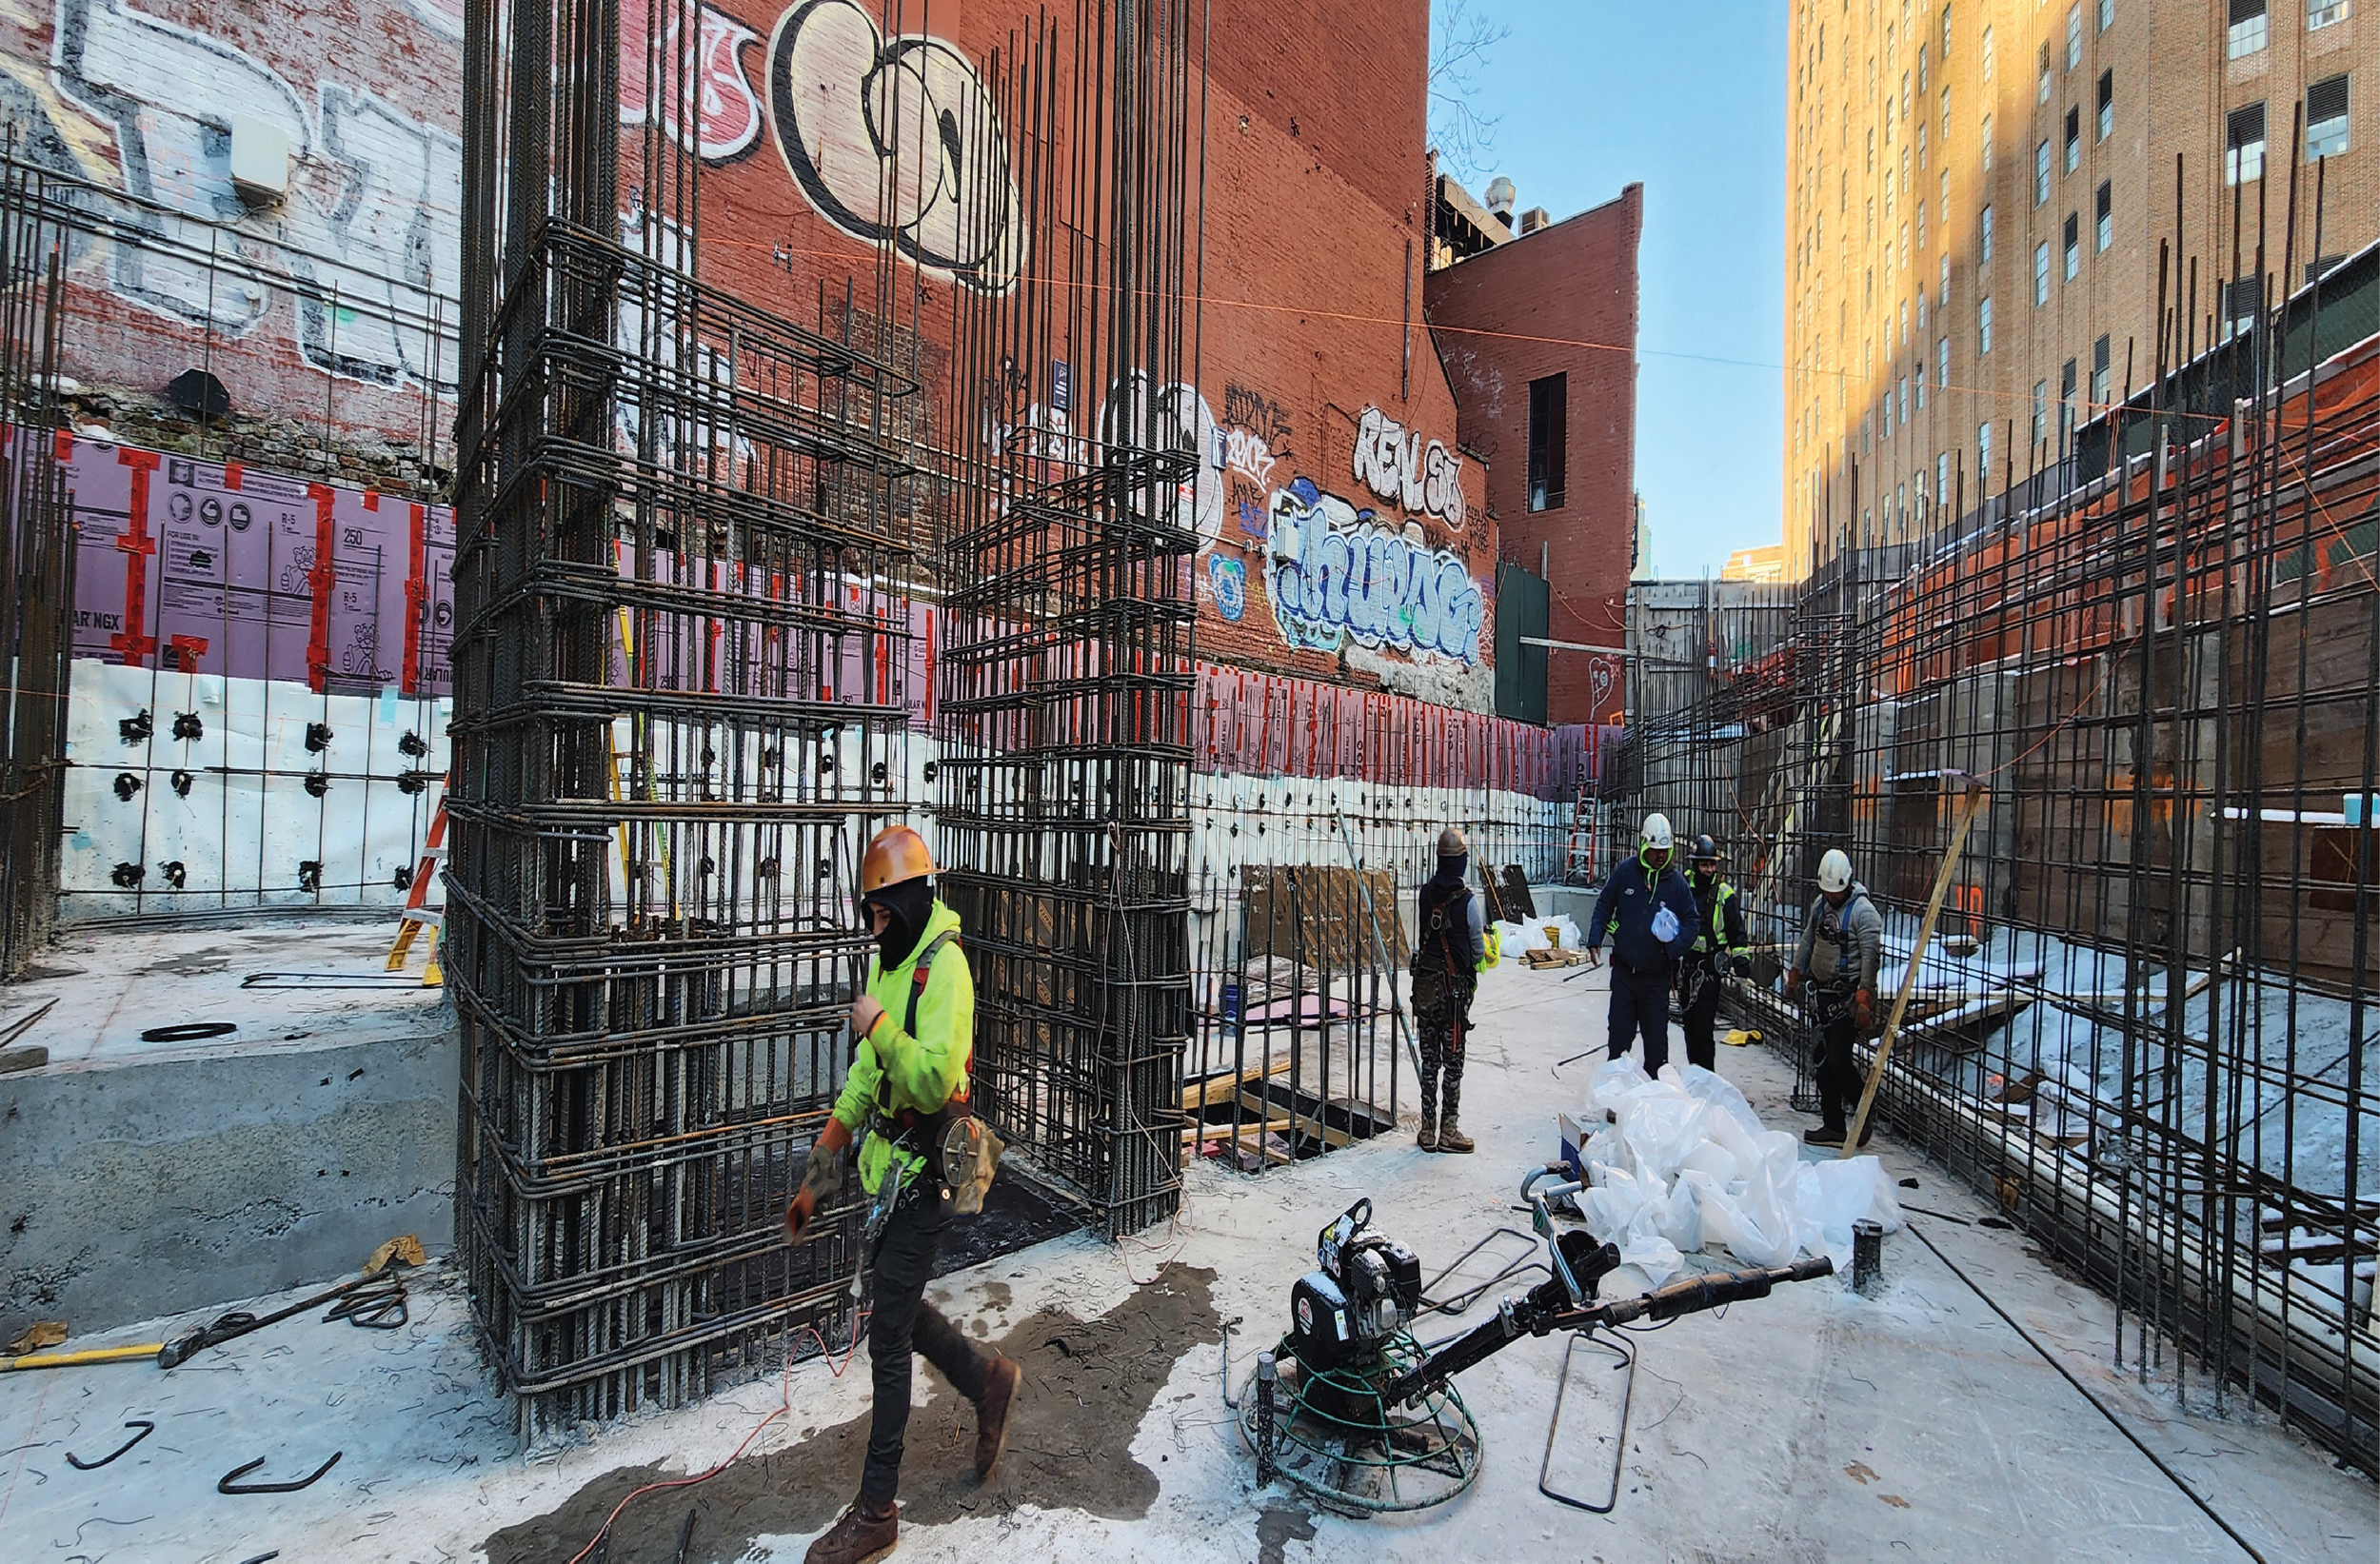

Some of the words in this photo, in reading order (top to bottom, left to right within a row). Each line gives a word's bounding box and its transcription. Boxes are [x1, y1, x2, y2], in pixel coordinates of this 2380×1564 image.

[344, 527, 363, 546] 250
[344, 591, 358, 604] R-5
[93, 611, 120, 631] NGX
